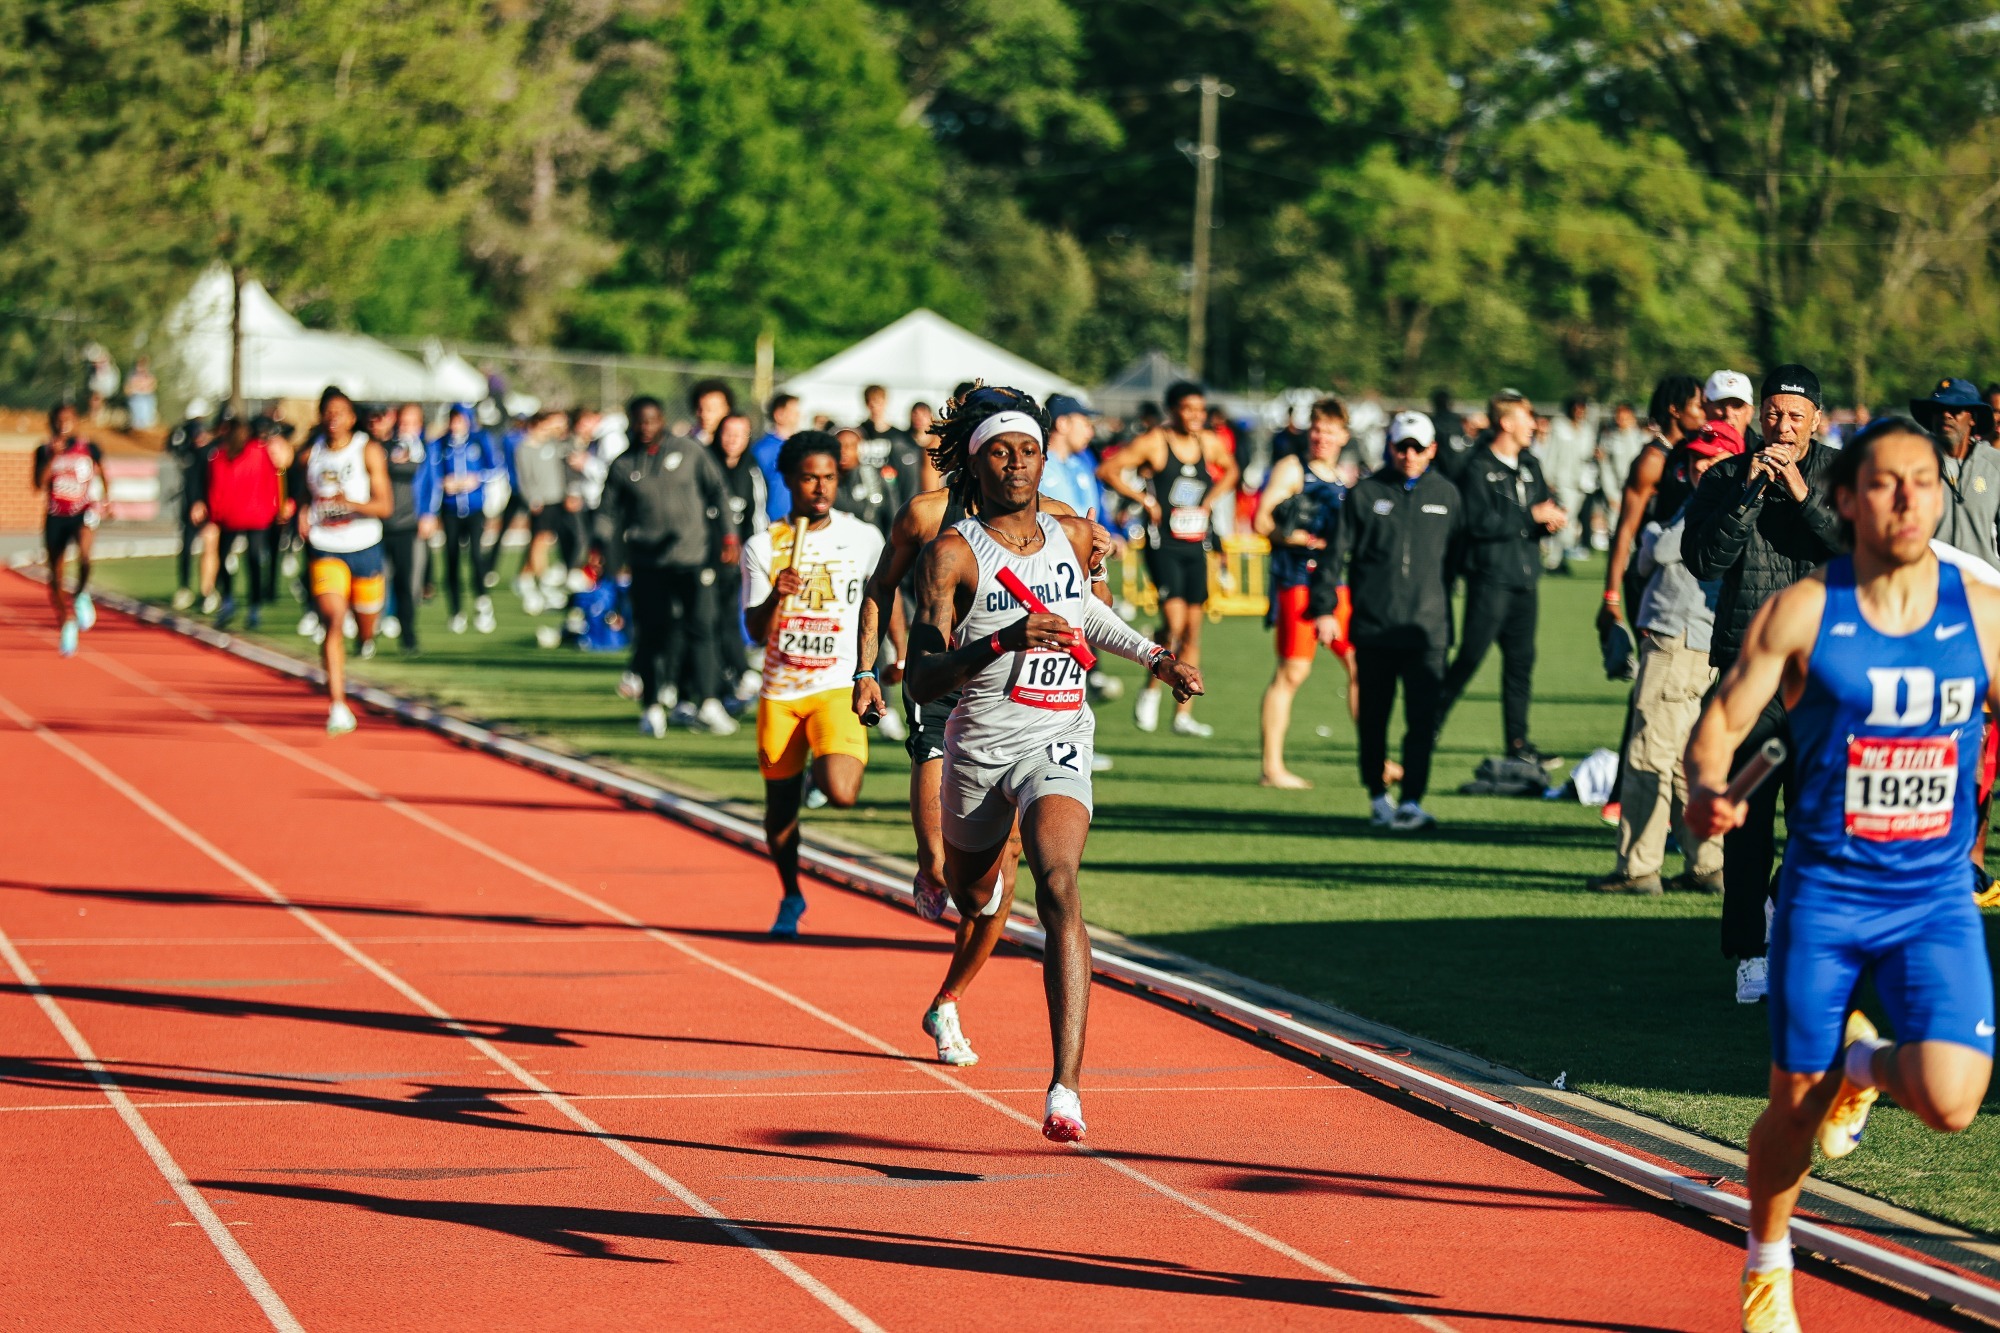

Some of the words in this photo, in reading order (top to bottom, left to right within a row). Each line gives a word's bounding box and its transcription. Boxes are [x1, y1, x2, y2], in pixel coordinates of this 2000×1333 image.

[846, 578, 859, 605] 6
[1056, 562, 1080, 599] 2
[783, 633, 835, 655] 2446
[1028, 657, 1082, 687] 1874
[1045, 691, 1080, 703] adidas
[1946, 686, 1962, 722] 5
[1056, 742, 1079, 773] 2
[1861, 745, 1890, 769] NC
[1890, 745, 1946, 769] STATE
[1857, 773, 1949, 809] 1935
